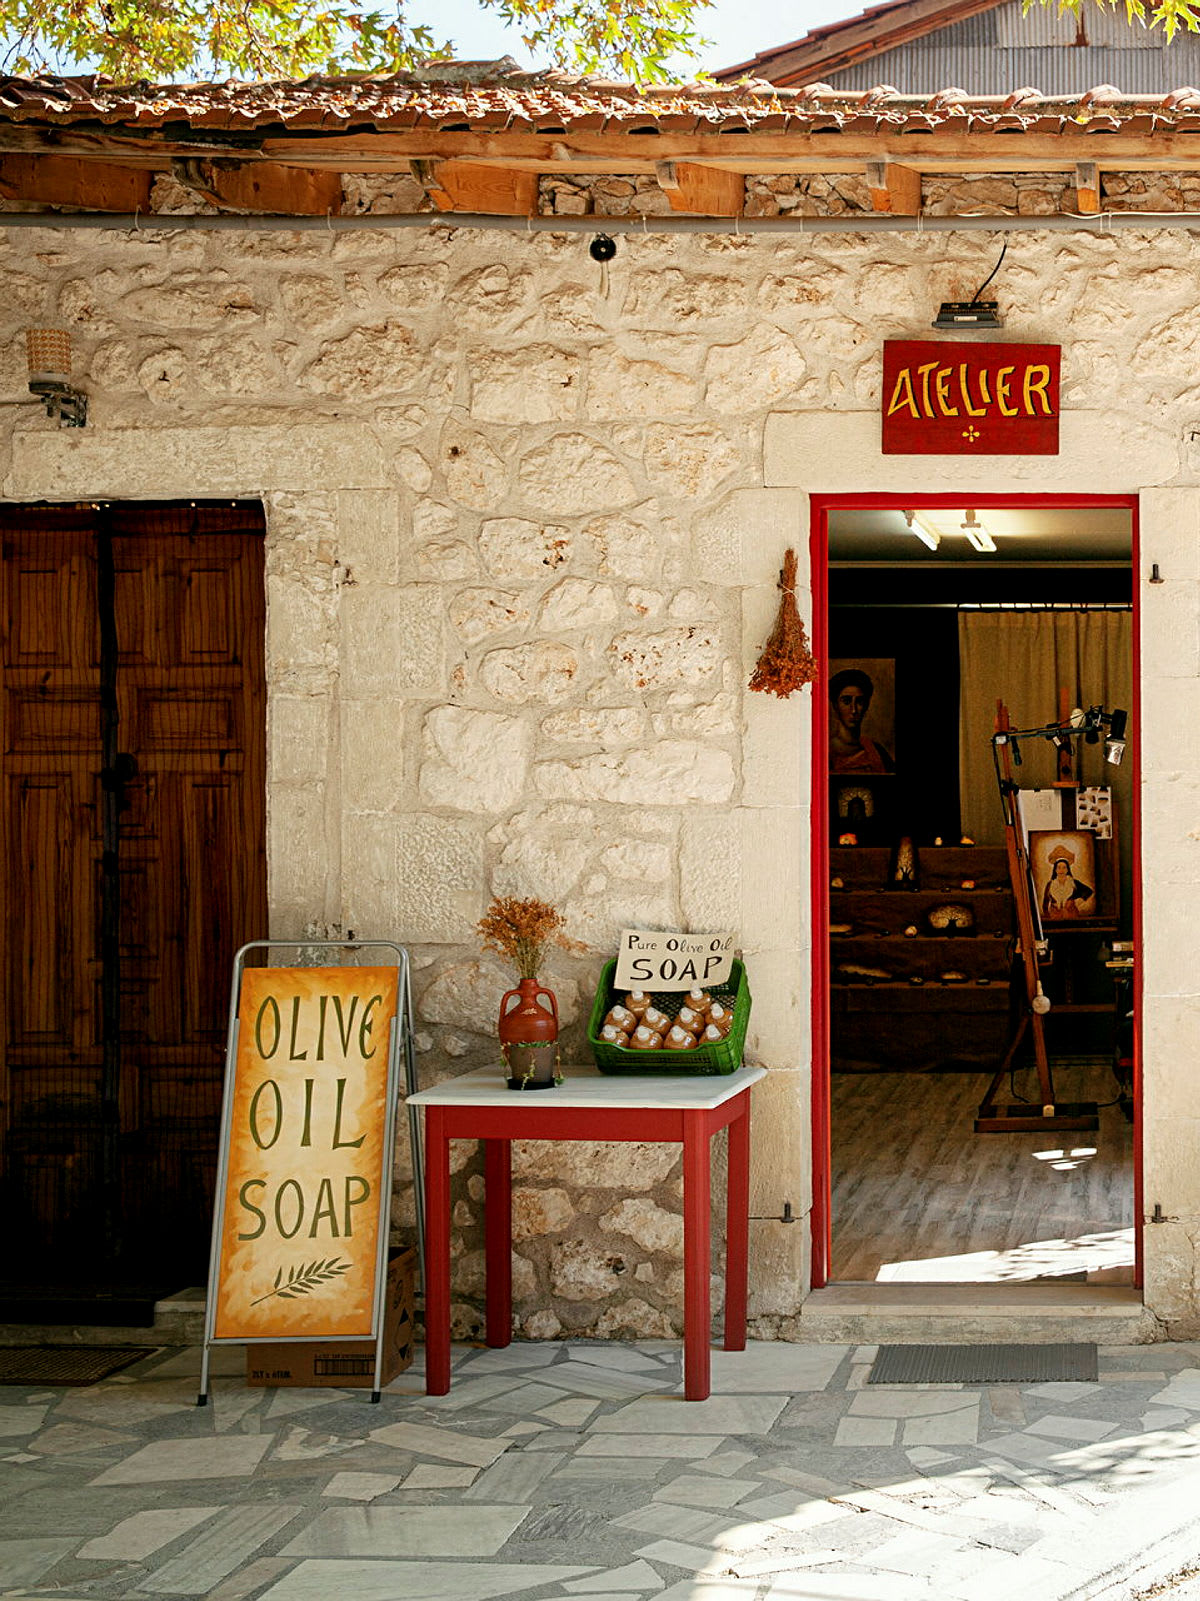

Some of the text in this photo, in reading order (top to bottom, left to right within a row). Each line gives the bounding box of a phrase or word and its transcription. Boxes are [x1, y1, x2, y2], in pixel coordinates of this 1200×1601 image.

[887, 361, 1054, 419] ATELIER
[628, 935, 734, 954] Pure Olive Oil
[629, 956, 723, 982] SOAP
[254, 995, 382, 1060] OLIVE
[248, 1077, 369, 1151] OIL
[237, 1175, 371, 1242] SOAP
